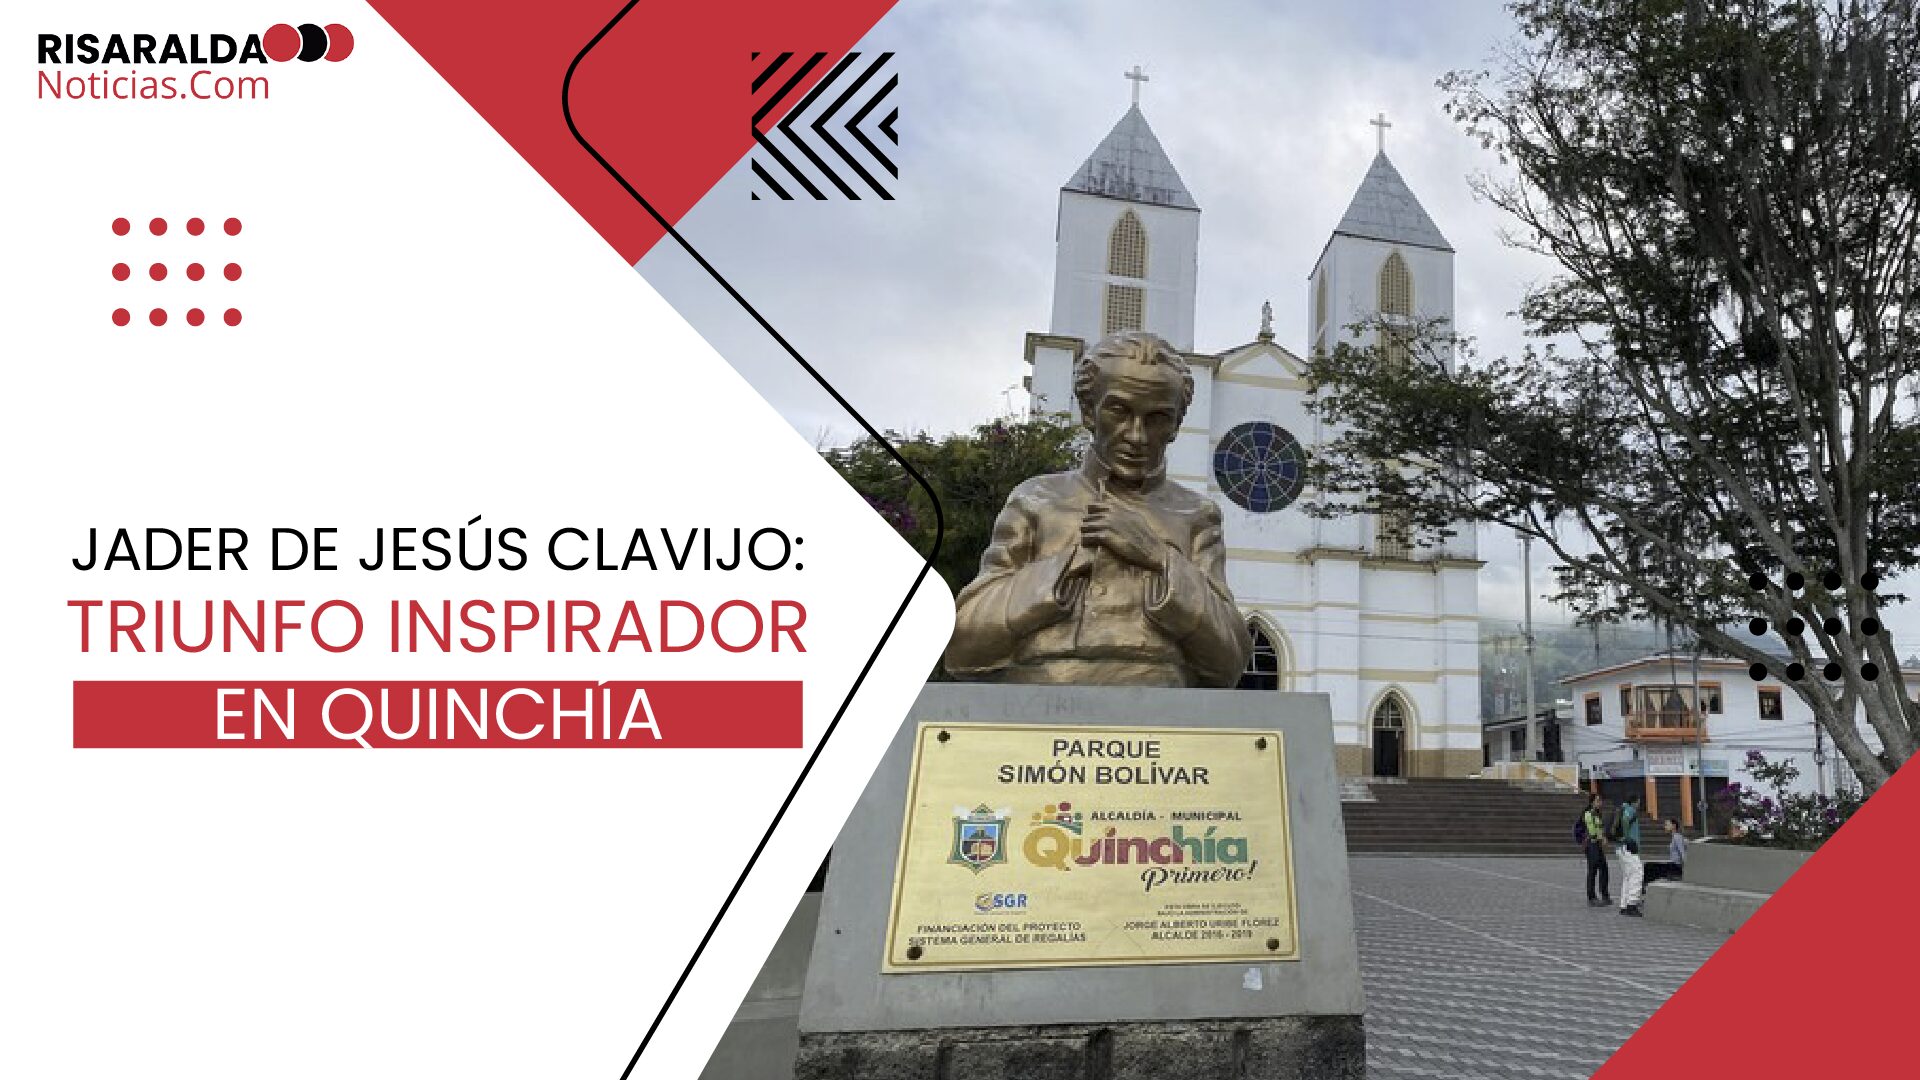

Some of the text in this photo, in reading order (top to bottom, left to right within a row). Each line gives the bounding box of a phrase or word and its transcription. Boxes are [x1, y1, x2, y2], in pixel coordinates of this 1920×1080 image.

[1053, 740, 1161, 759] PARQUE
[998, 761, 1210, 785] SIMÓN BOLÍVAR
[1091, 809, 1157, 821] ALCALDÍA
[1171, 810, 1242, 821] MUNICIPAL
[1024, 825, 1248, 871] Quinchía
[1140, 859, 1259, 892] Primero!
[993, 893, 1027, 908] SGR
